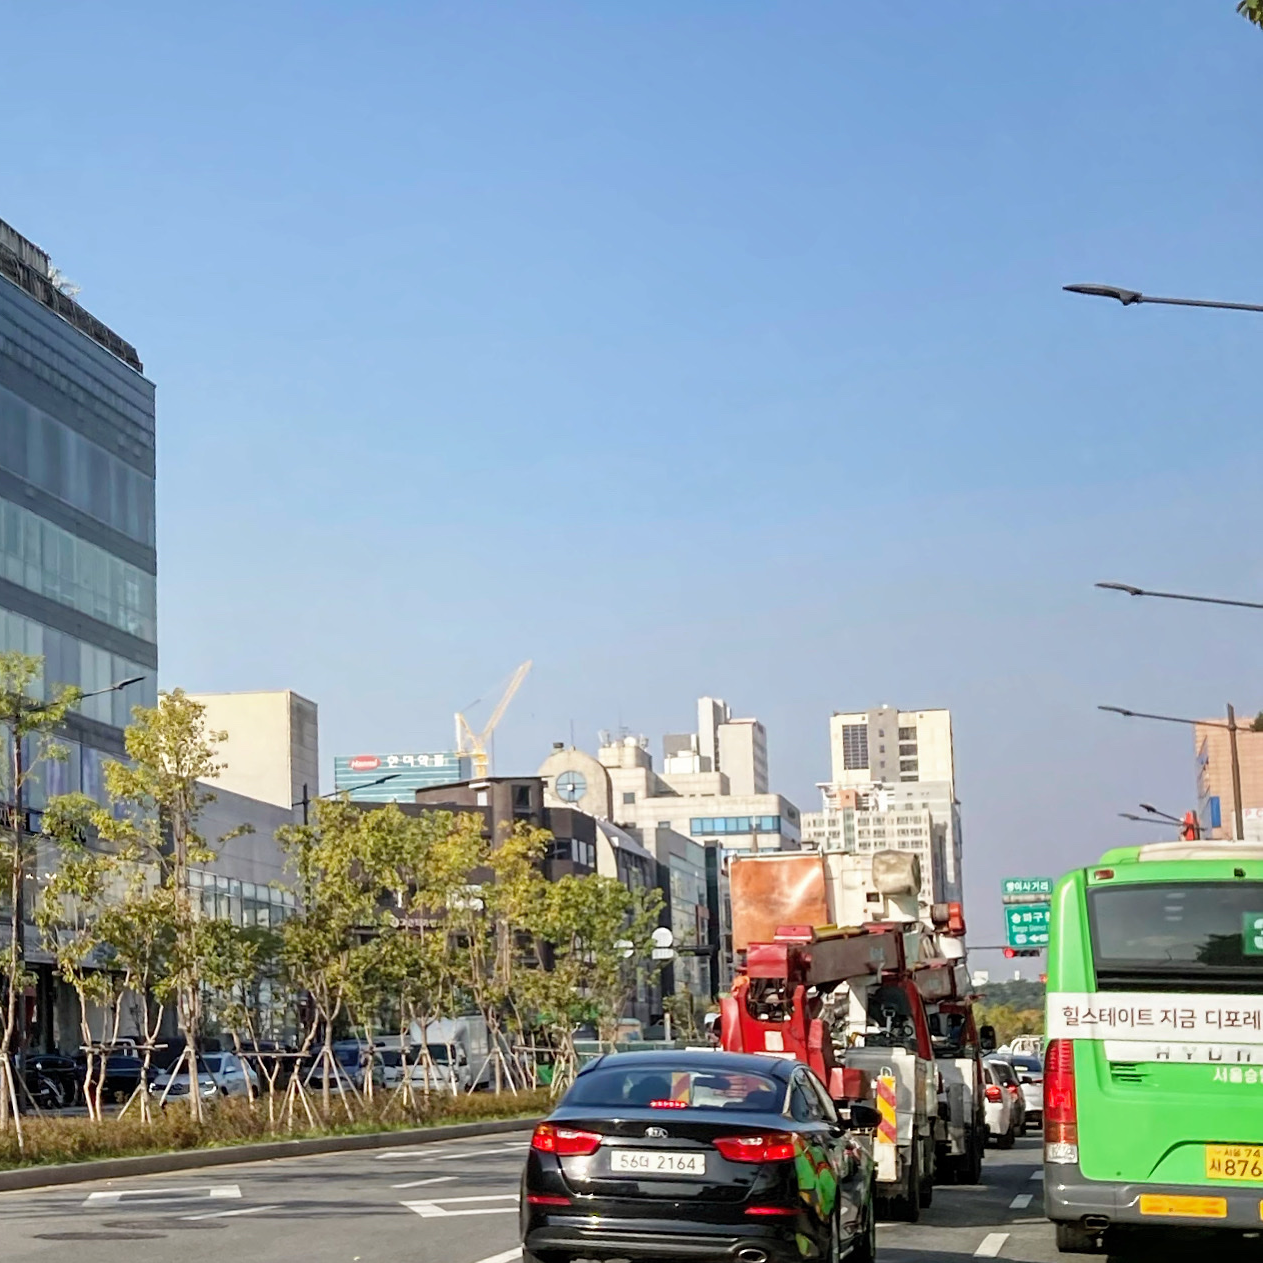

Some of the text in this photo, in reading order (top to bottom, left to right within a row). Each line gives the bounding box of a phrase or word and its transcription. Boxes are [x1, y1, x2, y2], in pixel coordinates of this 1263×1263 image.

[1062, 1005, 1262, 1031] 힐스테이트 지금 디포레
[657, 1155, 696, 1171] 2164
